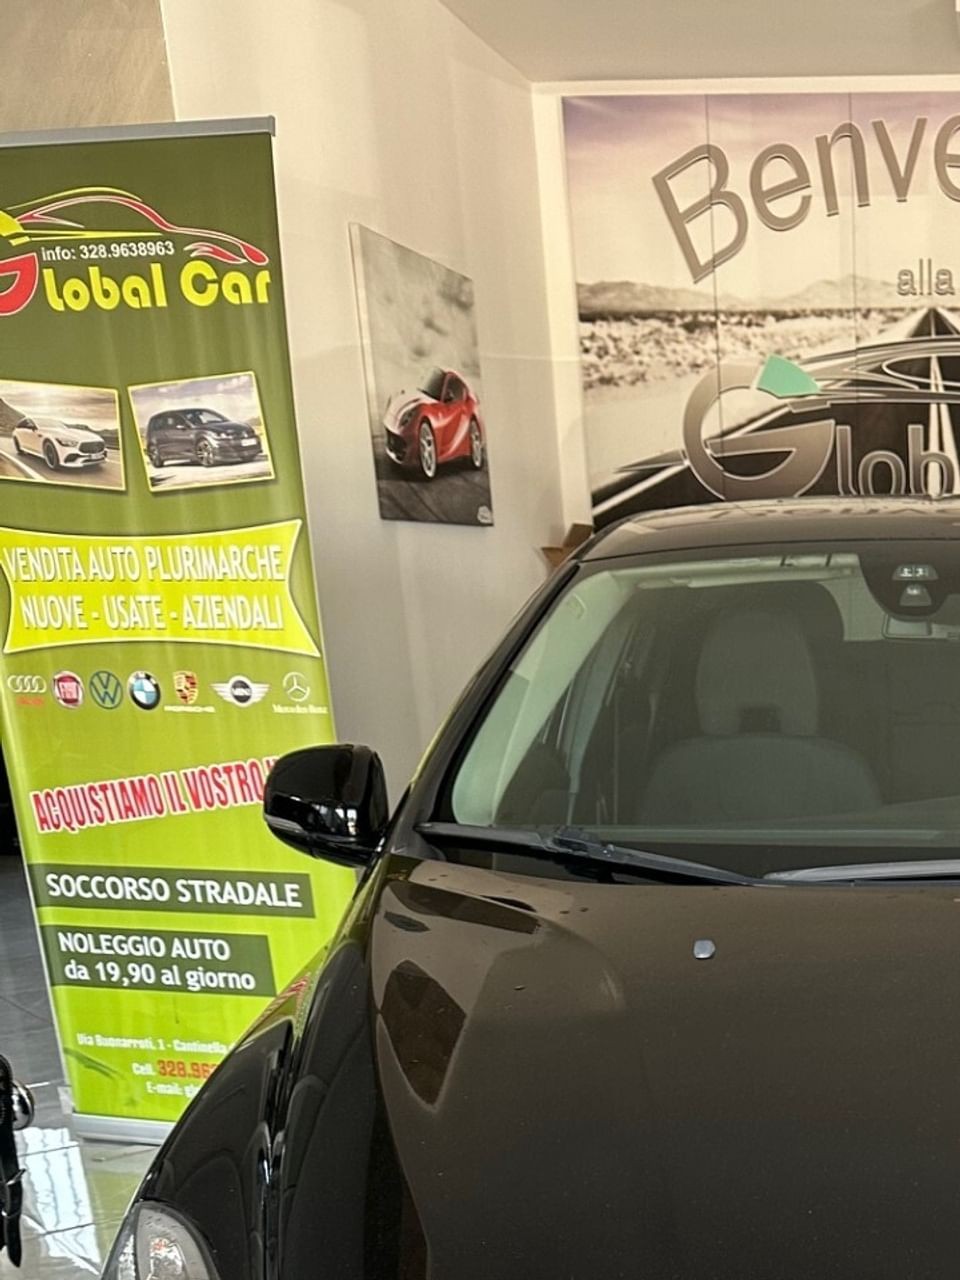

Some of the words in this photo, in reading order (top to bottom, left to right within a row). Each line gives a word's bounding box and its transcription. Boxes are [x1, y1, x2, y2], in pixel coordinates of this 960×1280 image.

[79, 240, 175, 260] 328.9638963
[180, 259, 271, 307] Car
[897, 258, 956, 296] alla
[5, 546, 90, 583] VENDITA
[89, 546, 141, 581] AUTO
[146, 545, 287, 582] PLURIMARCHE
[20, 595, 87, 629] NUOVE
[103, 595, 167, 629] USATE
[183, 595, 284, 629] AZIENDALI
[32, 776, 165, 833] ACQUISTIAMO
[164, 772, 187, 813] IL
[184, 760, 264, 809] VOSTRO
[45, 874, 170, 901] SOCCORSO
[177, 879, 303, 908] STRADALE
[57, 932, 166, 957] NOLEGGIO
[171, 938, 231, 961] AUTO
[64, 959, 90, 981] da
[94, 961, 156, 987] 19,90
[160, 967, 181, 986] al
[185, 968, 256, 992] giorno
